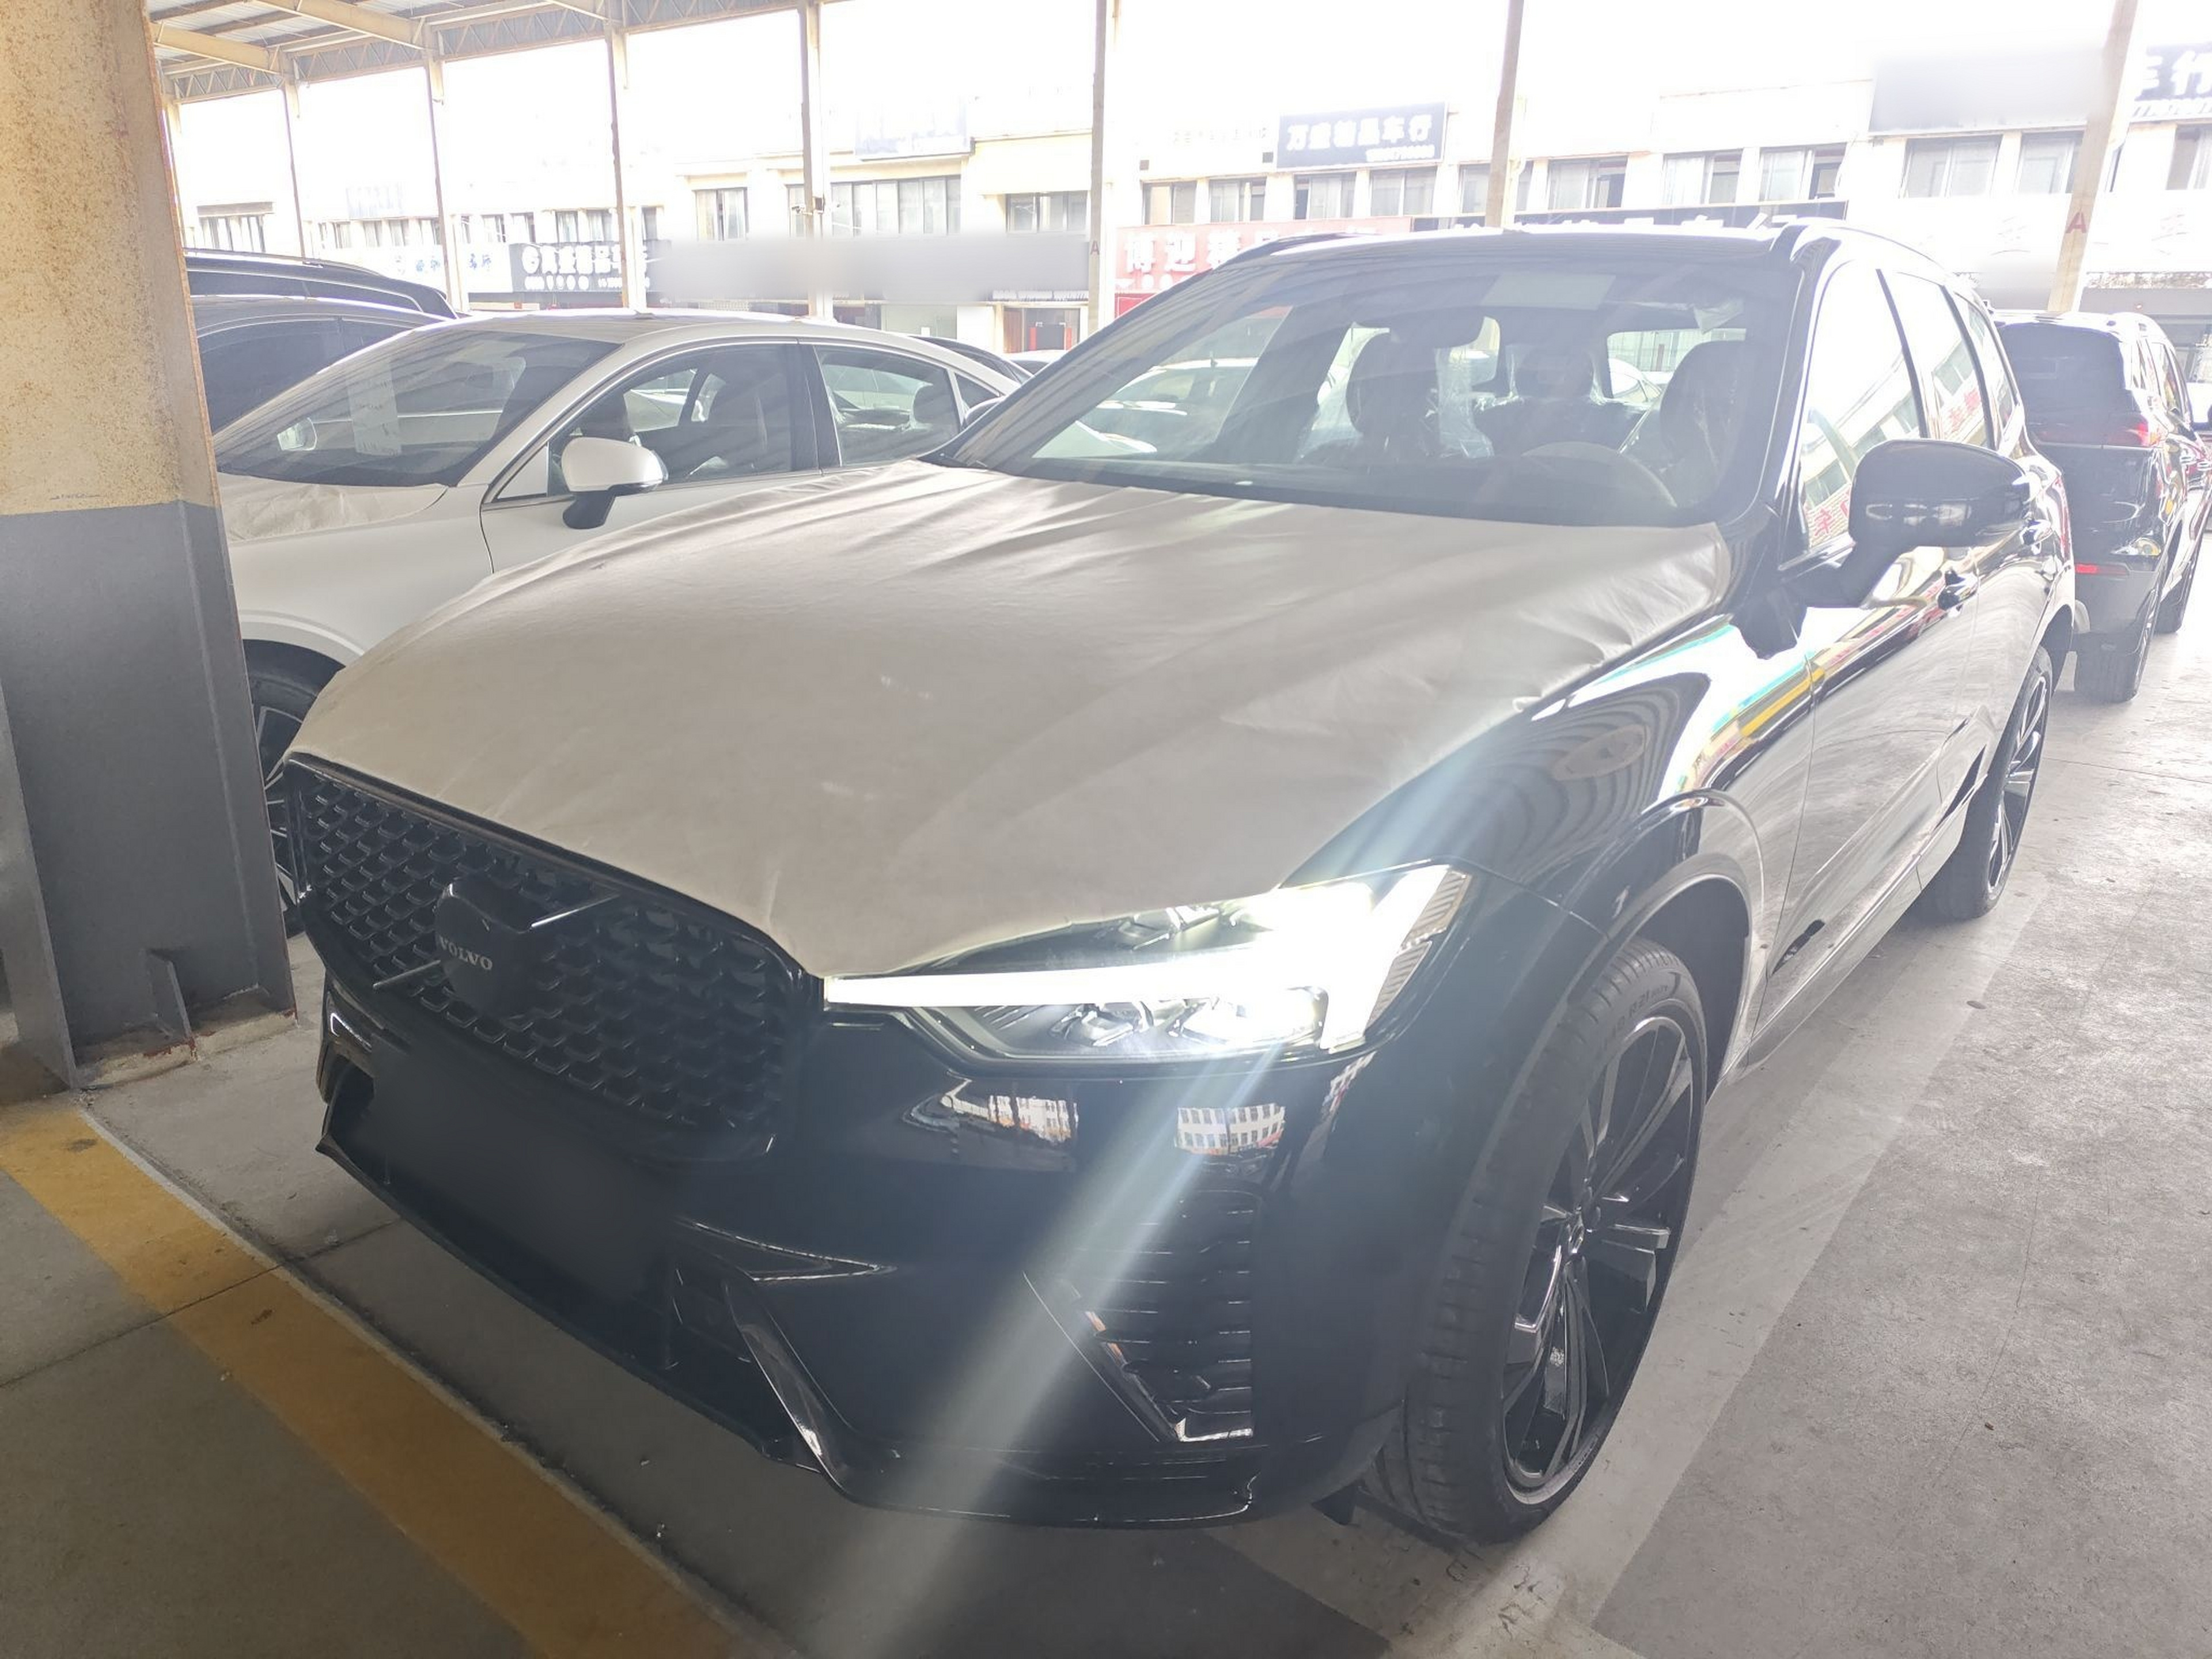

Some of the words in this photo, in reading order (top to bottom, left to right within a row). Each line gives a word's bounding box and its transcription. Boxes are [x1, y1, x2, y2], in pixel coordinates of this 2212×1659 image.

[2066, 212, 2087, 233] A
[1090, 240, 1100, 255] A
[439, 934, 493, 971] VOLVO
